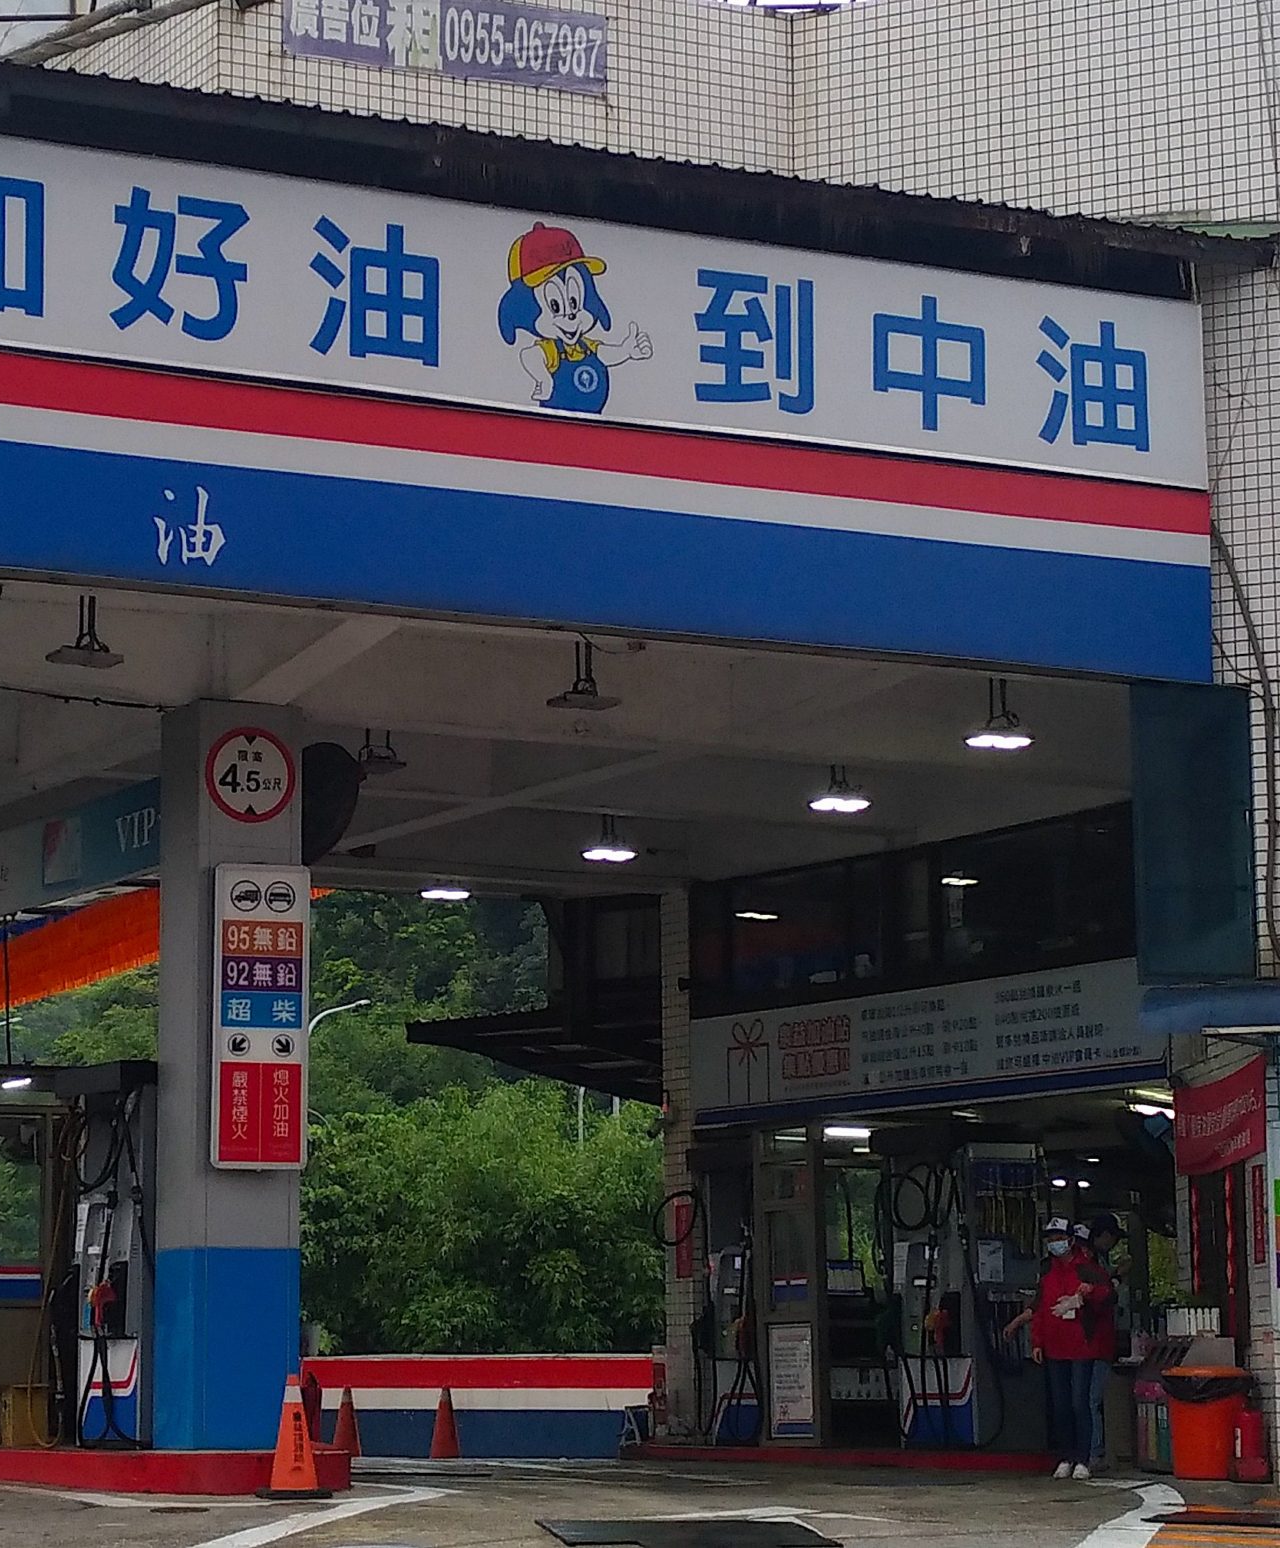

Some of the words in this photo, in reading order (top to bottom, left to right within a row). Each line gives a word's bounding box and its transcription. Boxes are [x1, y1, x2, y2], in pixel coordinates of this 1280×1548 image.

[445, 7, 602, 78] 0955-067987
[693, 267, 1150, 452] 到中油
[237, 750, 263, 762] 限高
[227, 925, 297, 951] 95無鉛
[226, 961, 296, 987] 92無鉛
[227, 998, 296, 1023] 超柴
[232, 1071, 248, 1139] 嚴禁煙火
[273, 1067, 289, 1137] 熄火加油
